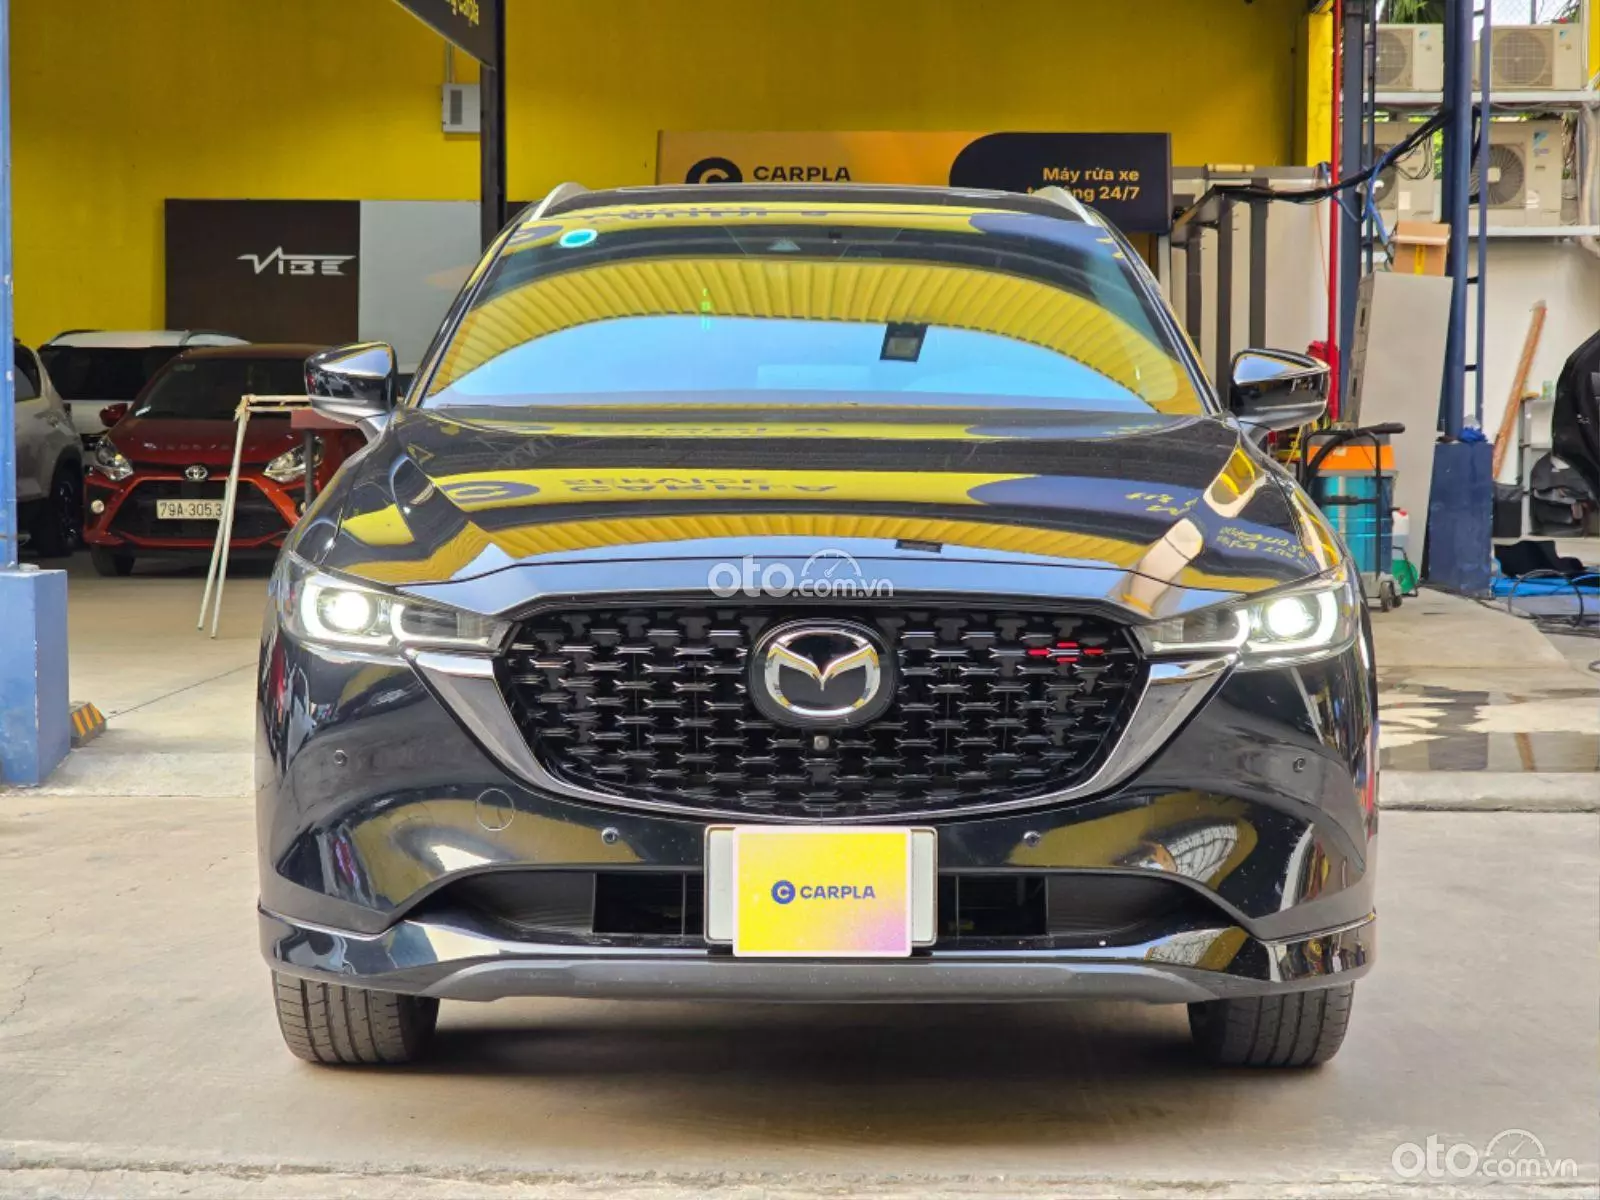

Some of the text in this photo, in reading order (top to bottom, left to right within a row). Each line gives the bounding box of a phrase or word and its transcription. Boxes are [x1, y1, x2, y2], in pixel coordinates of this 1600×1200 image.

[753, 166, 852, 181] CARPLA
[1042, 167, 1080, 183] Máy
[1119, 170, 1140, 181] xe
[1099, 186, 1140, 201] 24/7
[236, 245, 356, 276] VIBE
[800, 885, 876, 899] CARPLA
